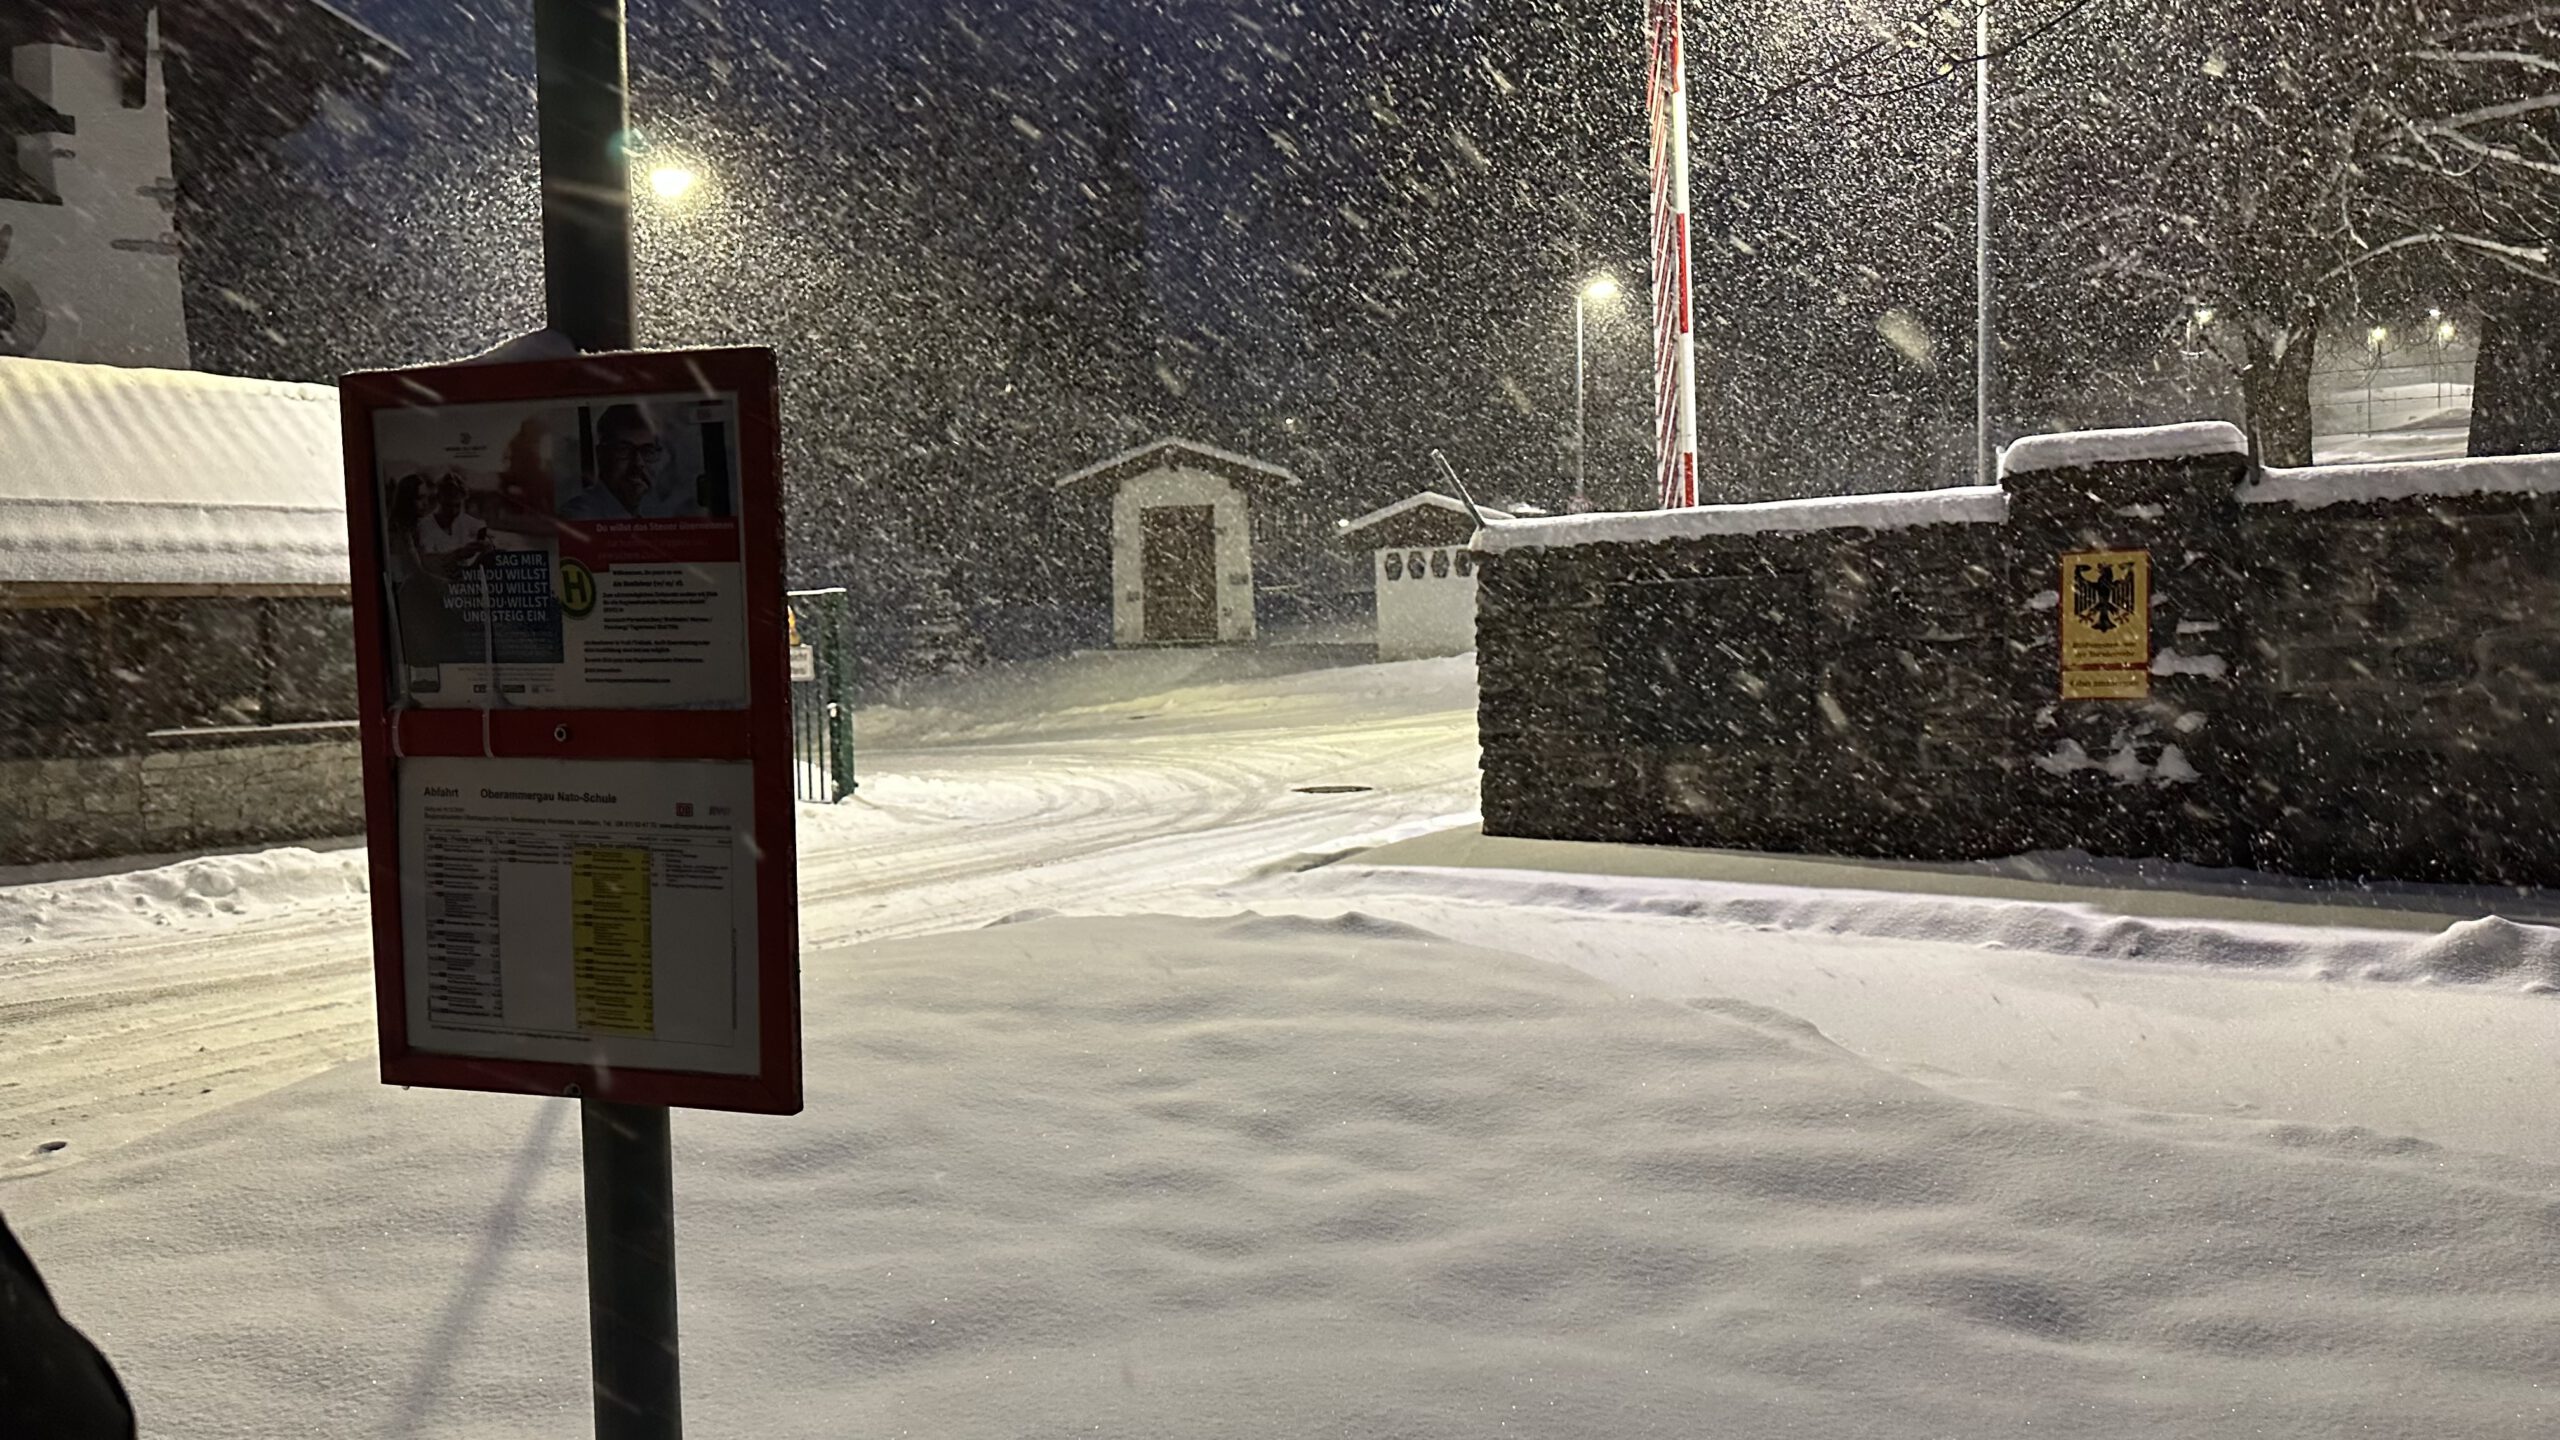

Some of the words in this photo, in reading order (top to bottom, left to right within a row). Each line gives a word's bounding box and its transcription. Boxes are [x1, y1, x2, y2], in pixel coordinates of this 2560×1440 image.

[596, 523, 608, 533] Du
[609, 522, 631, 532] willst
[633, 522, 648, 531] das
[649, 521, 678, 531] Steuer
[495, 554, 519, 566] SAG
[486, 568, 503, 581] DU
[506, 568, 548, 580] WILLST
[448, 583, 483, 595] WANN
[487, 582, 503, 595] DU
[506, 582, 549, 595] WILLST
[562, 570, 587, 603] H
[443, 596, 483, 609] WOHIN
[489, 596, 505, 608] DU
[506, 596, 550, 608] WILLST
[463, 610, 488, 623] UND
[492, 610, 524, 622] STEIG
[423, 787, 459, 798] Abfahrt
[480, 788, 555, 803] Oberammergau
[557, 791, 618, 804] Nato-Schule
